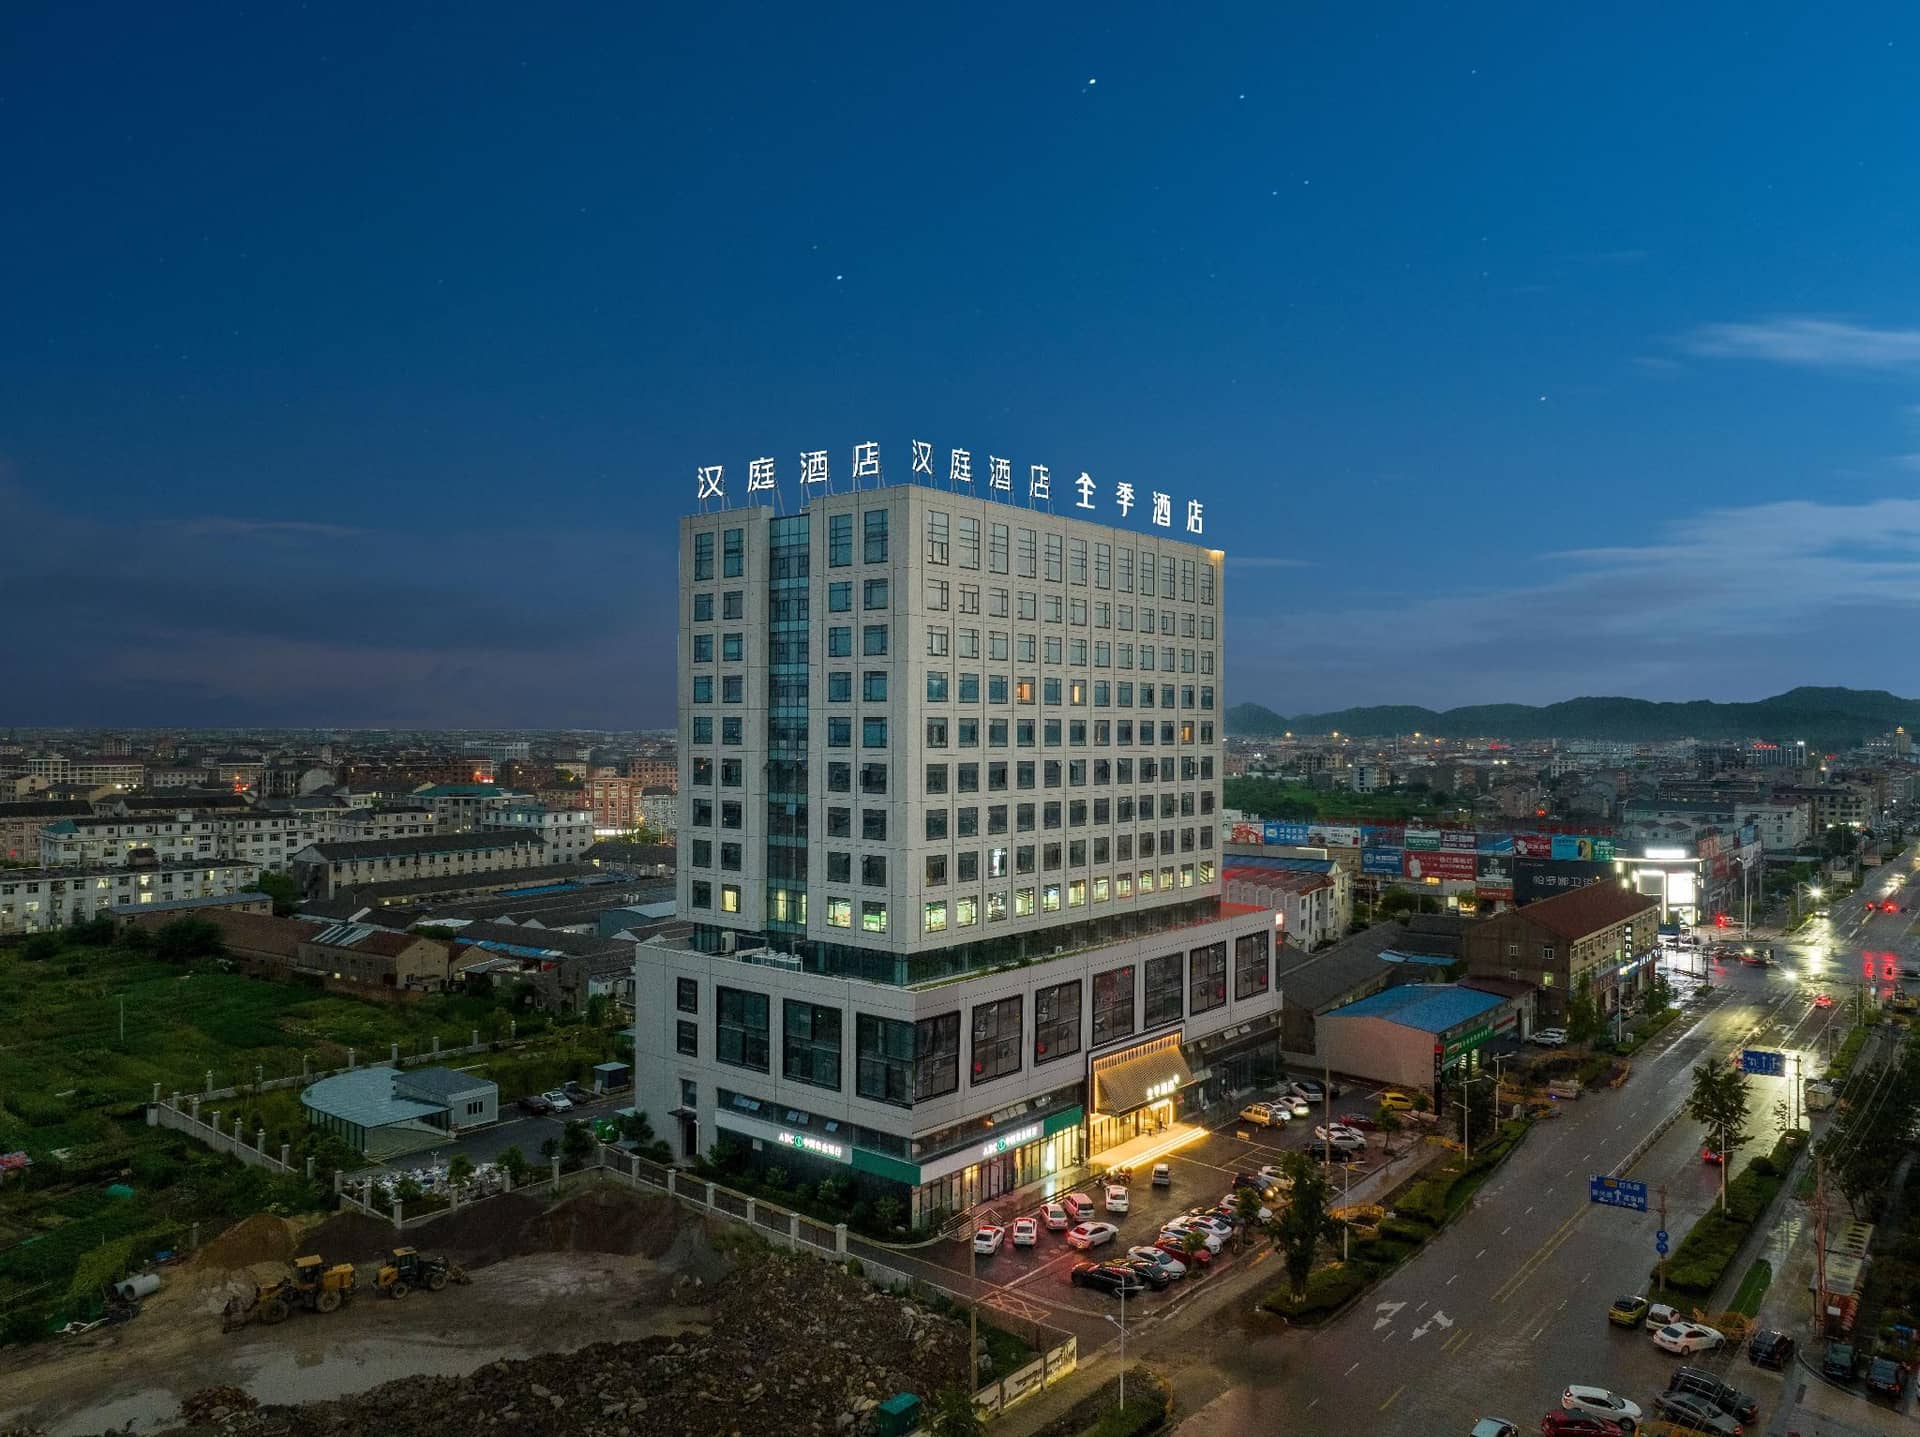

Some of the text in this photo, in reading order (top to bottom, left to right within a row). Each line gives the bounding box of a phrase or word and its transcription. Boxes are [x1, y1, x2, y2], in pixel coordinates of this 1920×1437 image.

[697, 440, 880, 499] 汉庭酒店
[911, 439, 1050, 500] 汉庭酒店
[1074, 472, 1204, 535] 全季酒店
